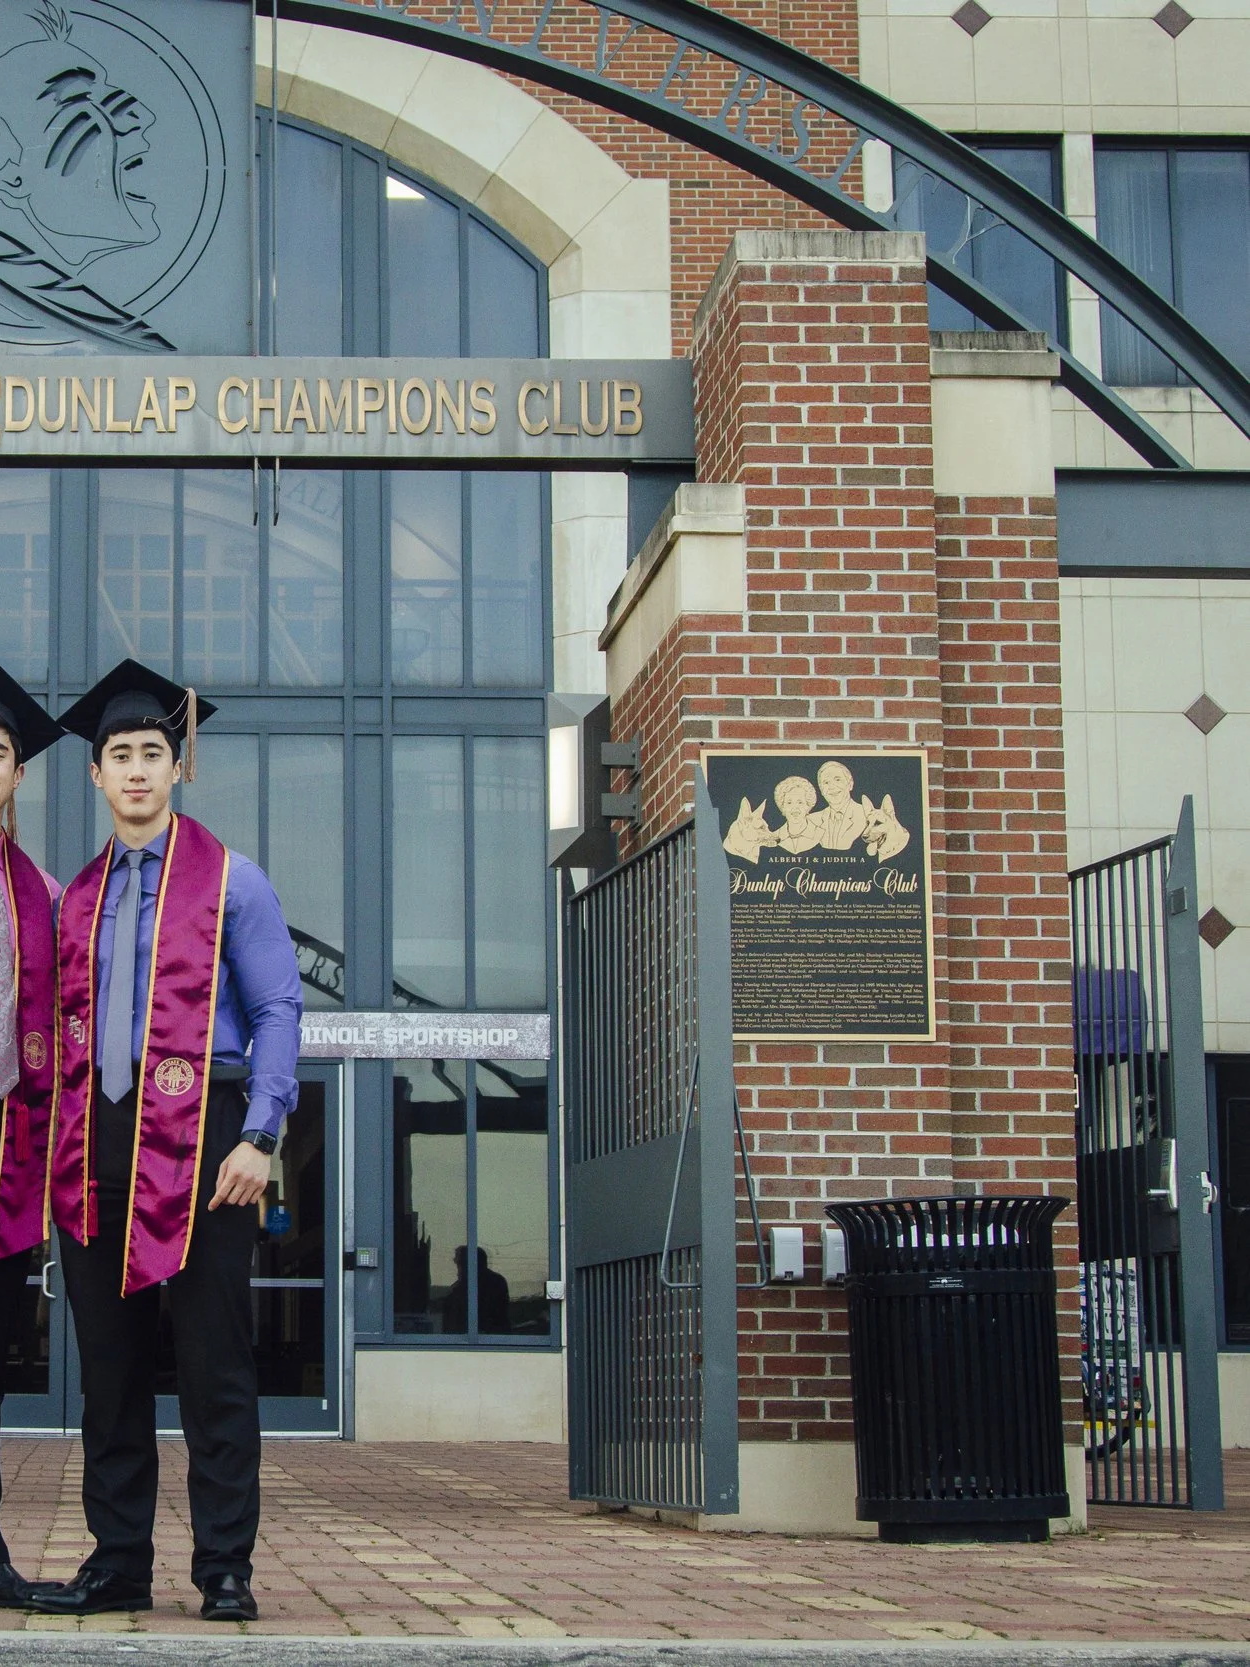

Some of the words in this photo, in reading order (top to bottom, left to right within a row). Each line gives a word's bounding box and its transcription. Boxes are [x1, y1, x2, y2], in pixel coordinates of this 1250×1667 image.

[3, 376, 197, 435] DUNLAP
[216, 376, 497, 436] CHAMPIONS
[517, 377, 643, 436] CLUB
[822, 856, 856, 864] JUDITH
[730, 867, 786, 900] Dunlap
[785, 866, 873, 900] Champions
[873, 867, 919, 900] Club
[301, 1026, 377, 1044] MINOLE
[382, 1027, 518, 1047] SPORTSHOP
